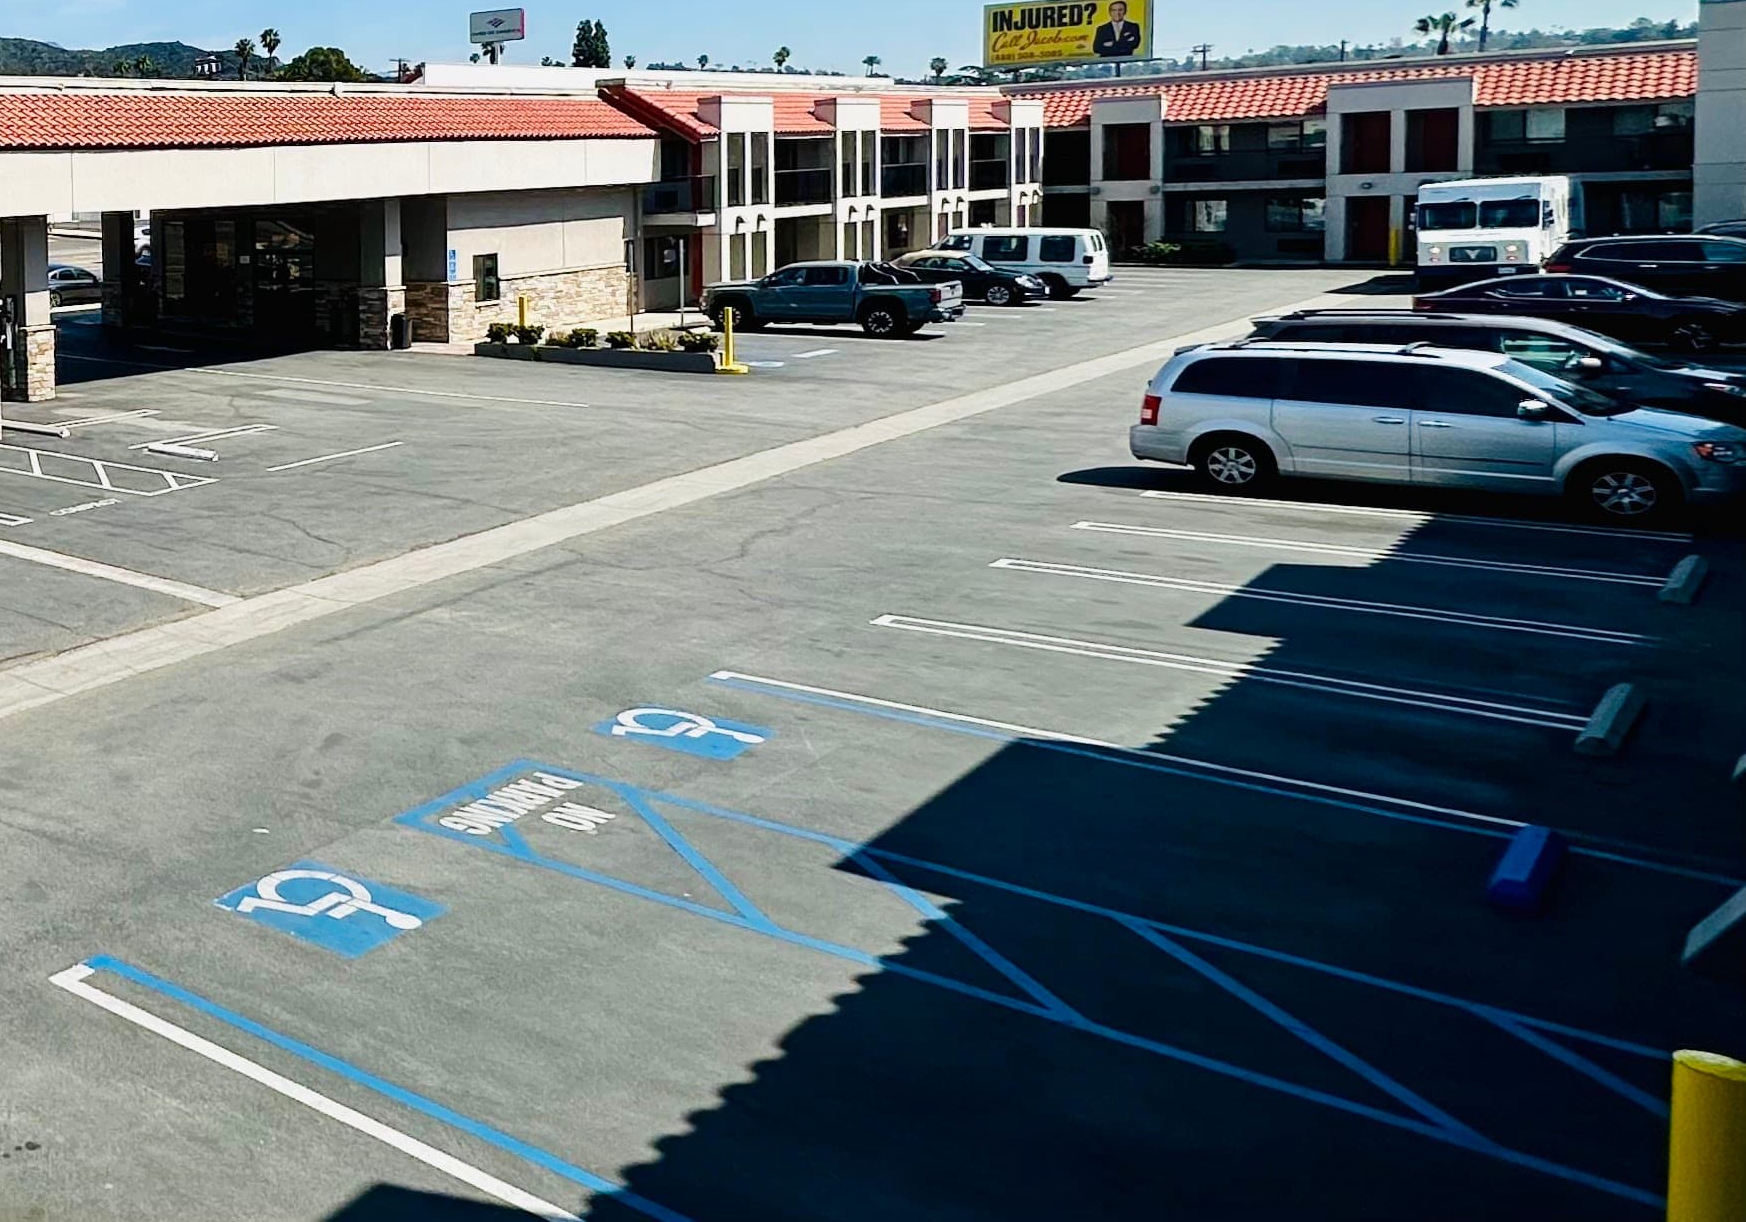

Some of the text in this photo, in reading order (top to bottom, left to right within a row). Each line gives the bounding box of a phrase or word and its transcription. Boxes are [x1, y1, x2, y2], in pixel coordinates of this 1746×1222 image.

[992, 2, 1098, 32] INJURED?
[992, 32, 1019, 53] Call
[438, 771, 584, 836] PARKING
[541, 801, 617, 834] NO
